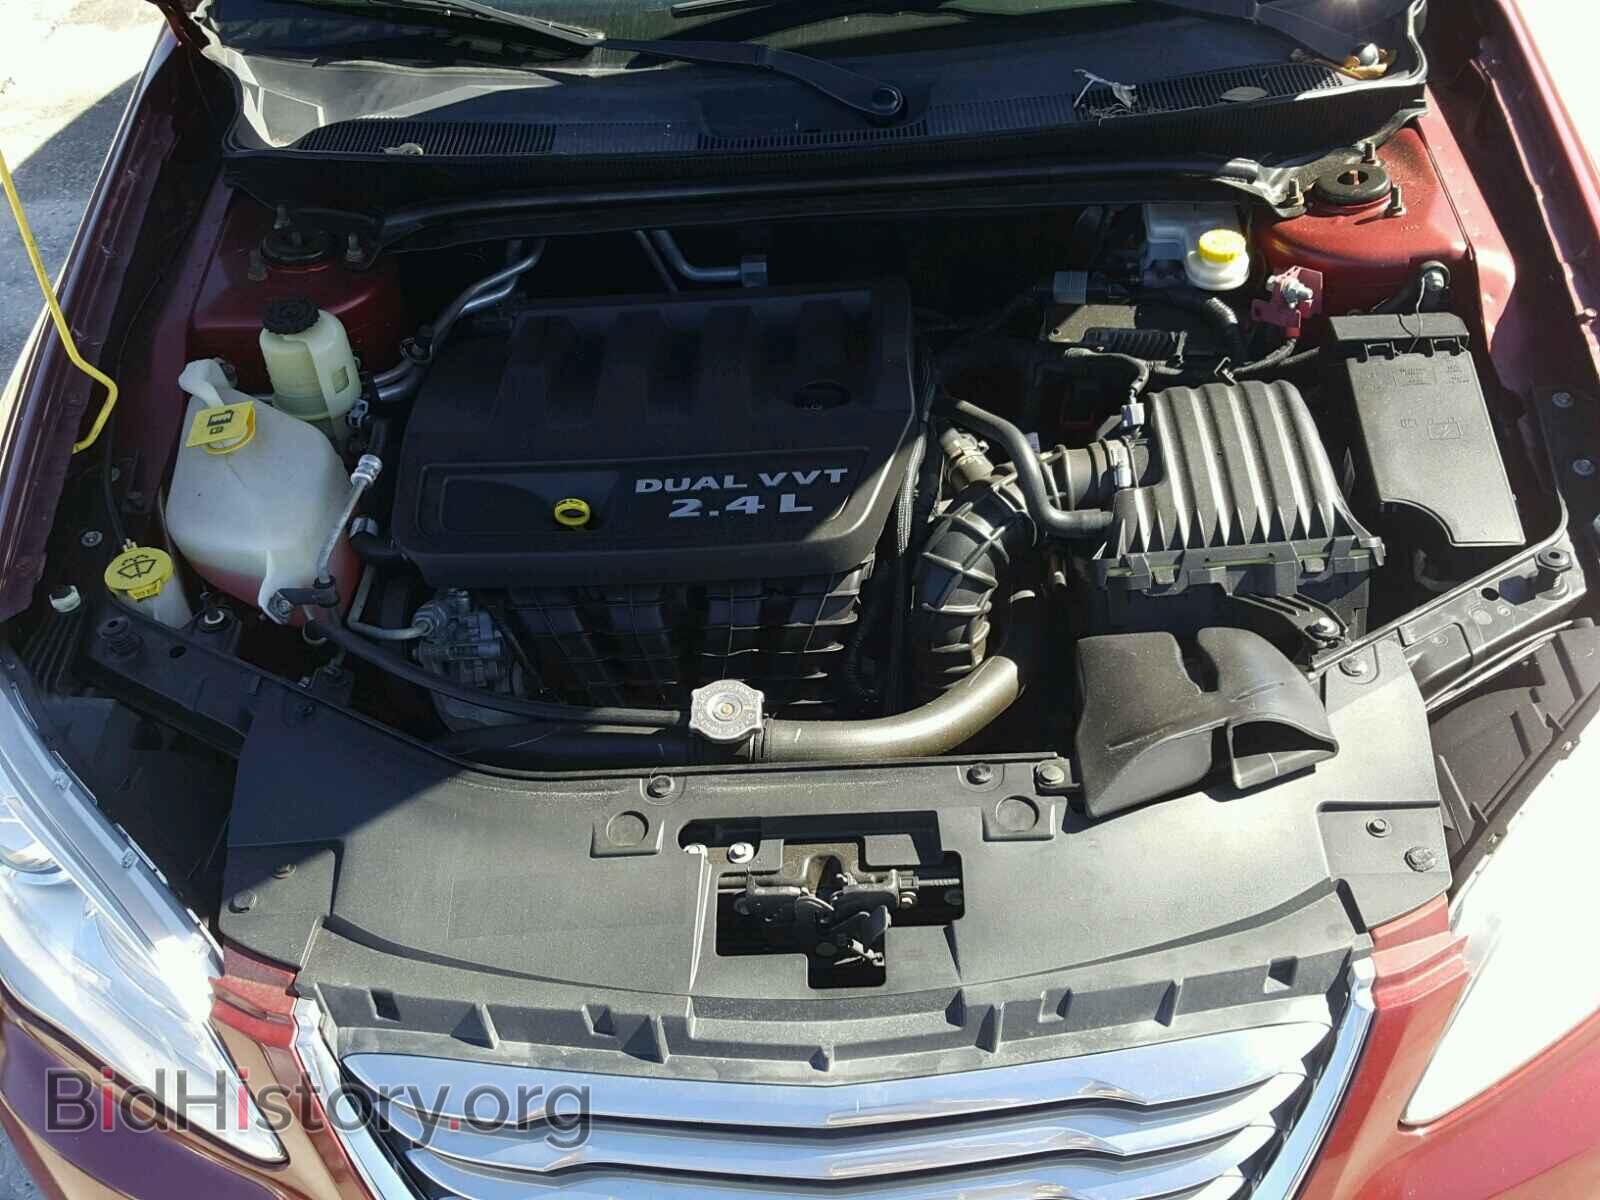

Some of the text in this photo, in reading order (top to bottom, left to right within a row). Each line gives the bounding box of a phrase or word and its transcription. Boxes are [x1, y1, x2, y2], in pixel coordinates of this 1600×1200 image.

[635, 468, 848, 493] DUAL VVT
[668, 493, 813, 518] 2.4 L
